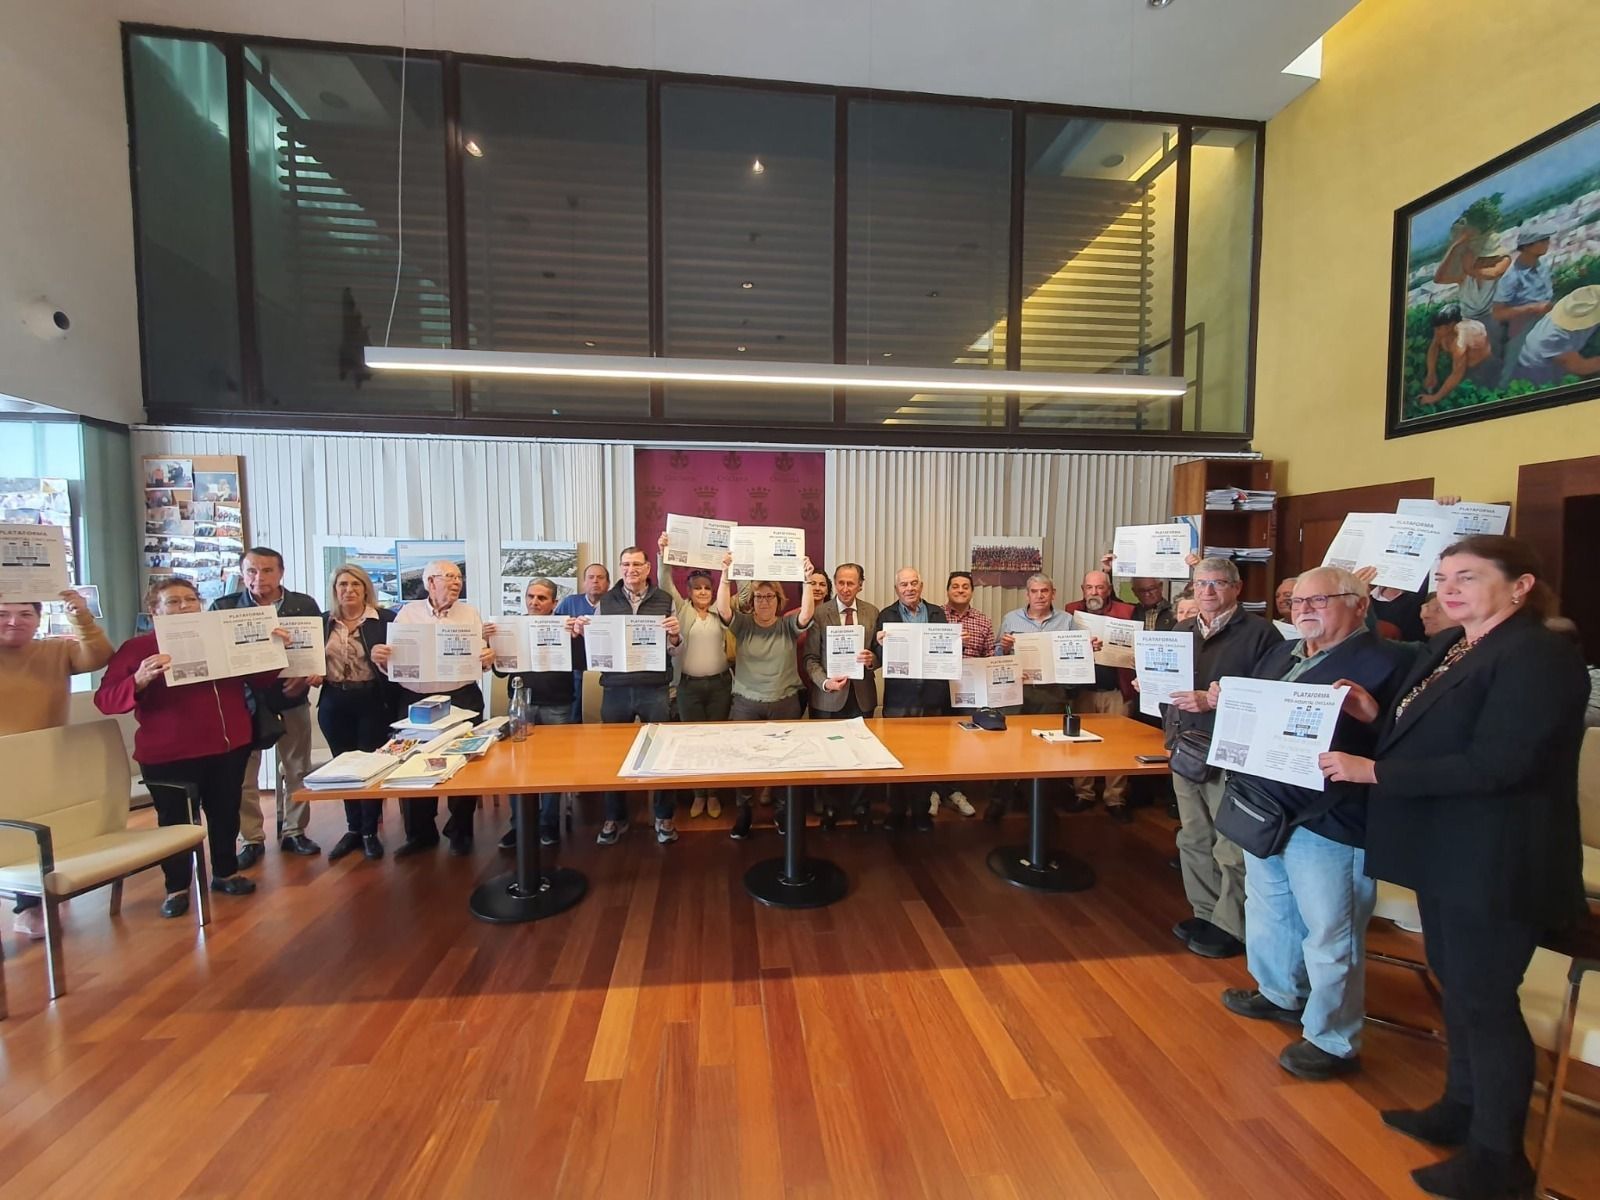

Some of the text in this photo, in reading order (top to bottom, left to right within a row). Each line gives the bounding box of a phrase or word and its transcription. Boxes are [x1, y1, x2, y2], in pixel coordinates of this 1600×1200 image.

[1396, 520, 1434, 529] PLATAFORMA
[228, 611, 264, 619] PLATAFORMA
[1293, 691, 1330, 699] PLATAFORMA
